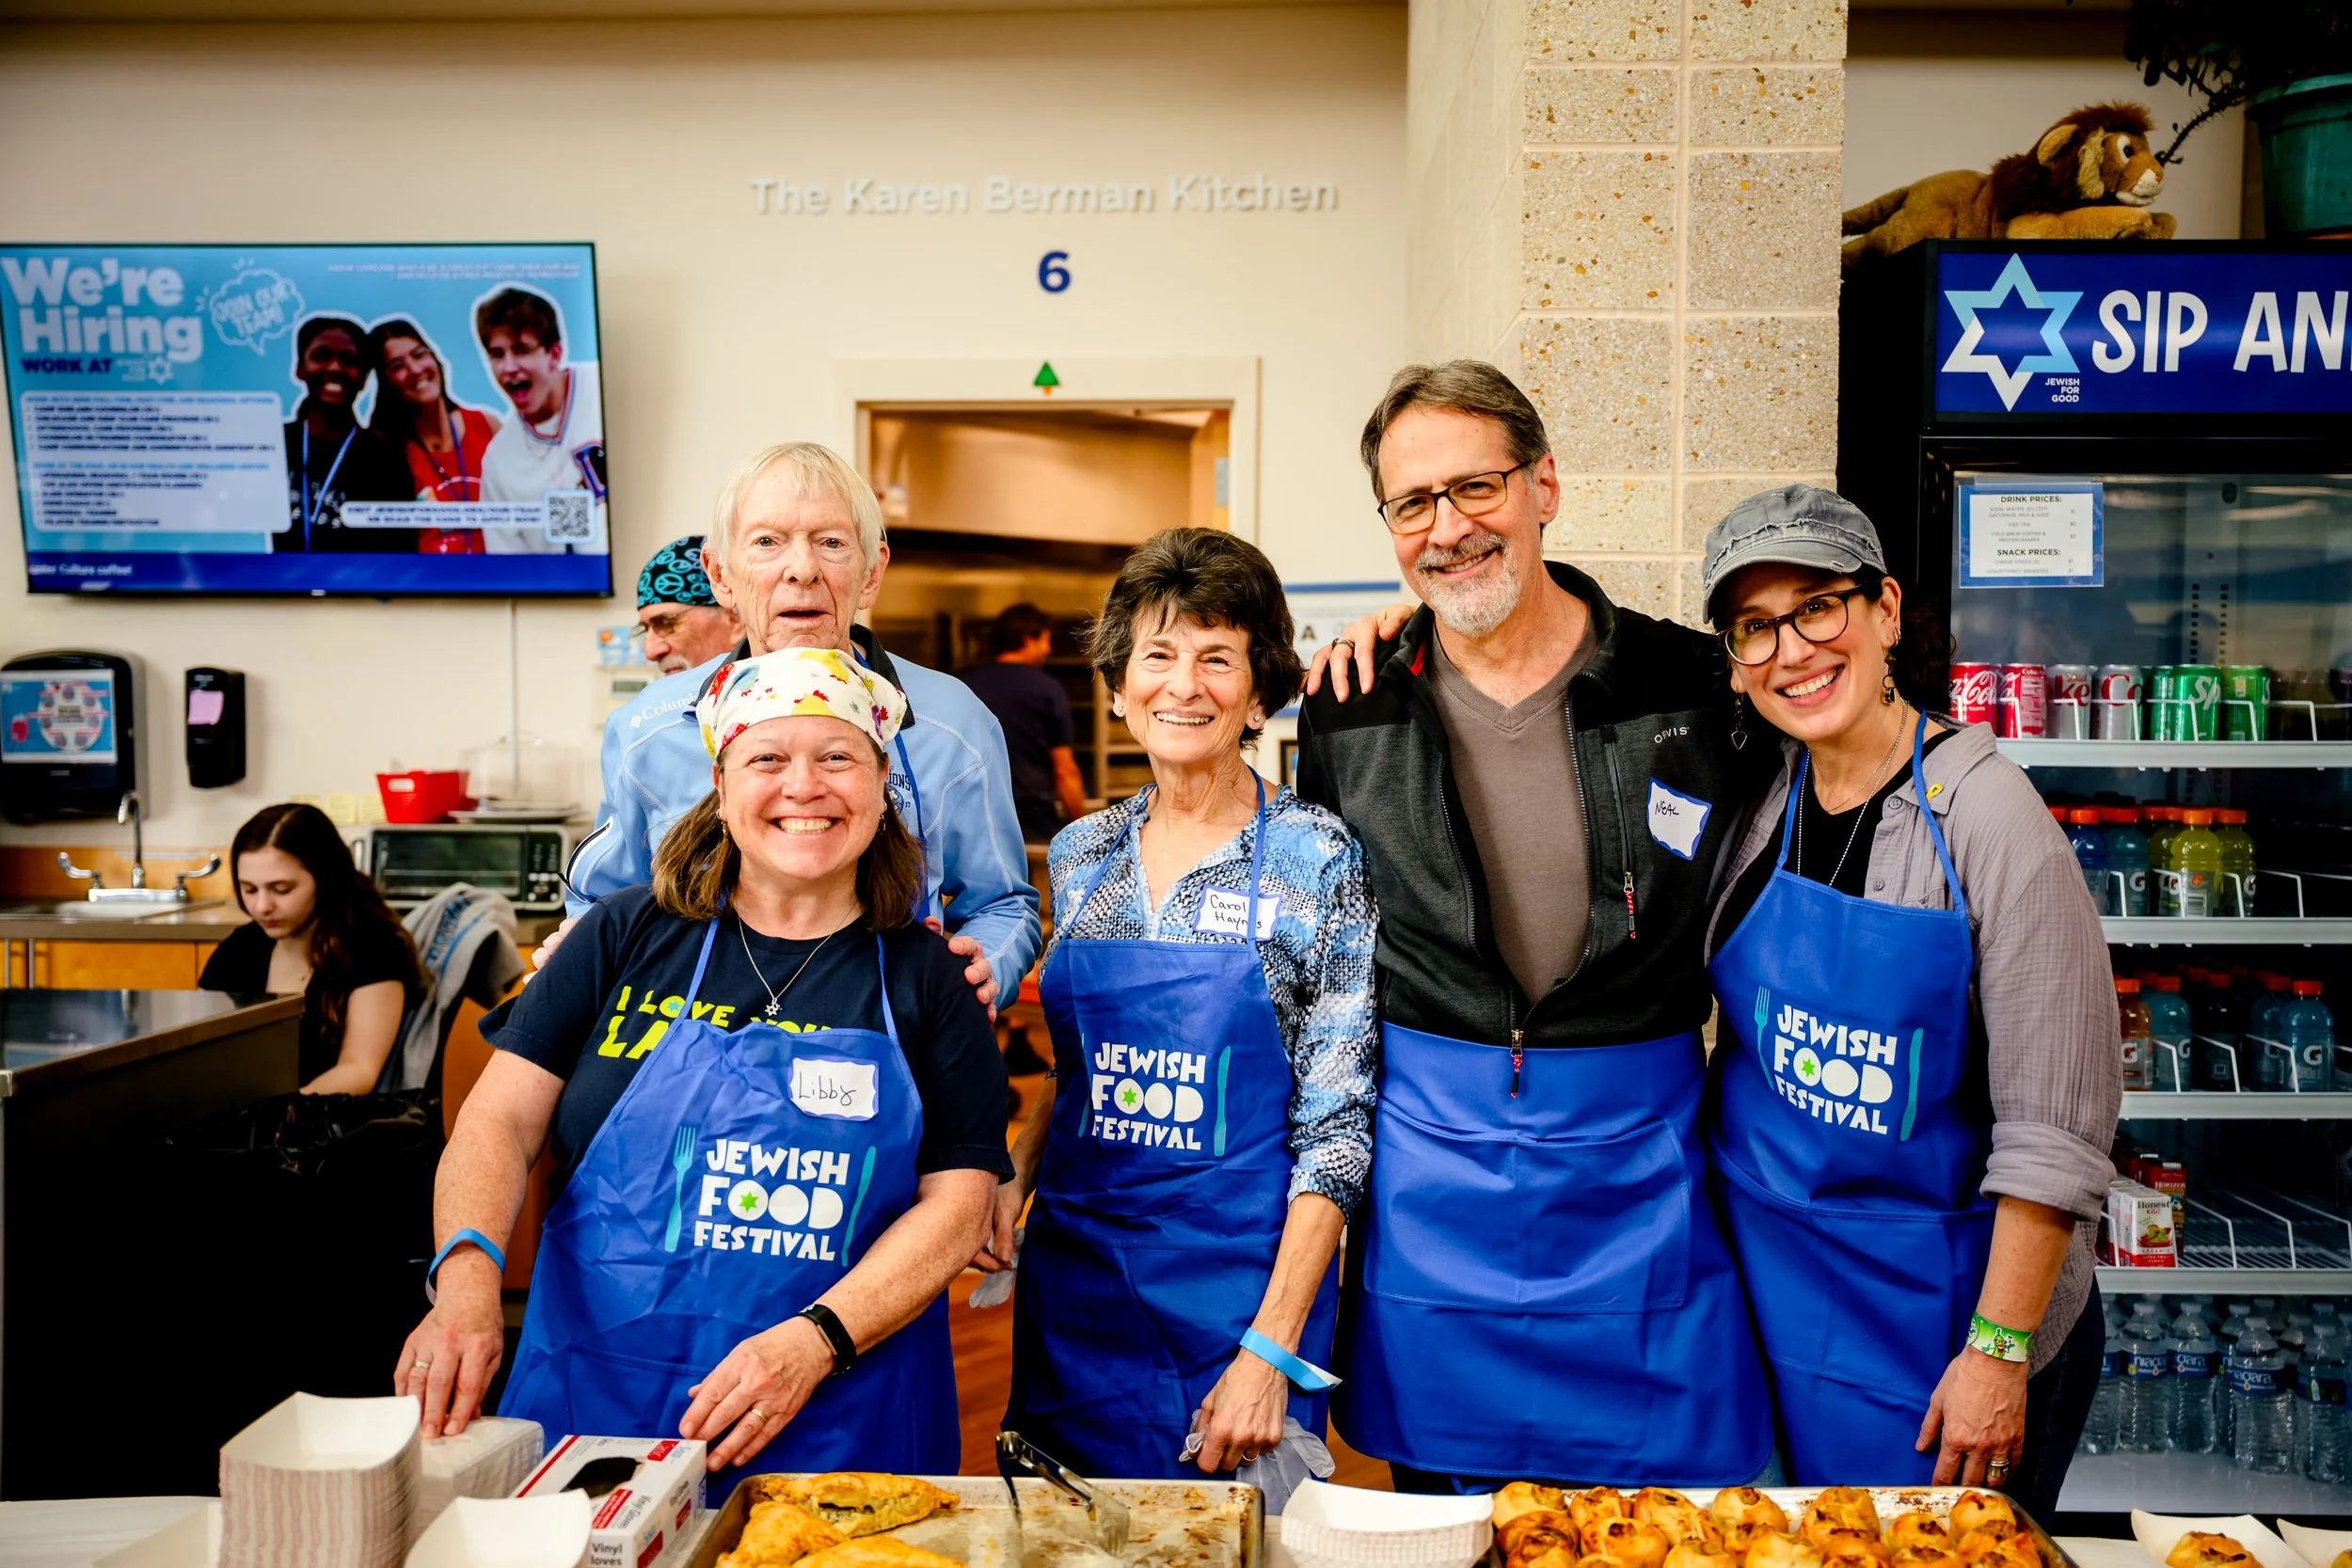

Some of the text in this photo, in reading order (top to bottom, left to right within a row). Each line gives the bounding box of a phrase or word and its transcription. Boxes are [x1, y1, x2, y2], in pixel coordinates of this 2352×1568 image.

[749, 173, 1339, 214] The Karen Berman Kitchen
[1038, 251, 1071, 293] 6
[19, 306, 202, 363] Hiring
[2091, 290, 2352, 373] SIP AN
[21, 358, 83, 374] WORK
[88, 357, 112, 374] AT
[2044, 377, 2080, 386] JEWISH
[2051, 394, 2080, 403] GOOD
[1301, 626, 1316, 641] A
[1210, 894, 1247, 911] Carol
[1215, 911, 1263, 930] Hayns
[616, 985, 632, 1012] I
[638, 990, 736, 1028] LOVE
[1777, 1004, 1898, 1066] JEWISH
[1095, 1042, 1206, 1084] JEWISH
[1773, 1034, 1893, 1103] FOOD
[799, 1071, 857, 1106] Libby
[1091, 1074, 1203, 1123] FOOD
[1774, 1074, 1888, 1135] FESTIVAL
[1091, 1117, 1201, 1150] FESTIVAL
[706, 1138, 850, 1185] JEWISH
[698, 1174, 843, 1229] FOOD
[693, 1220, 835, 1261] FESTIVAL
[590, 1556, 622, 1565] loves
[592, 1543, 623, 1556] Vinyl
